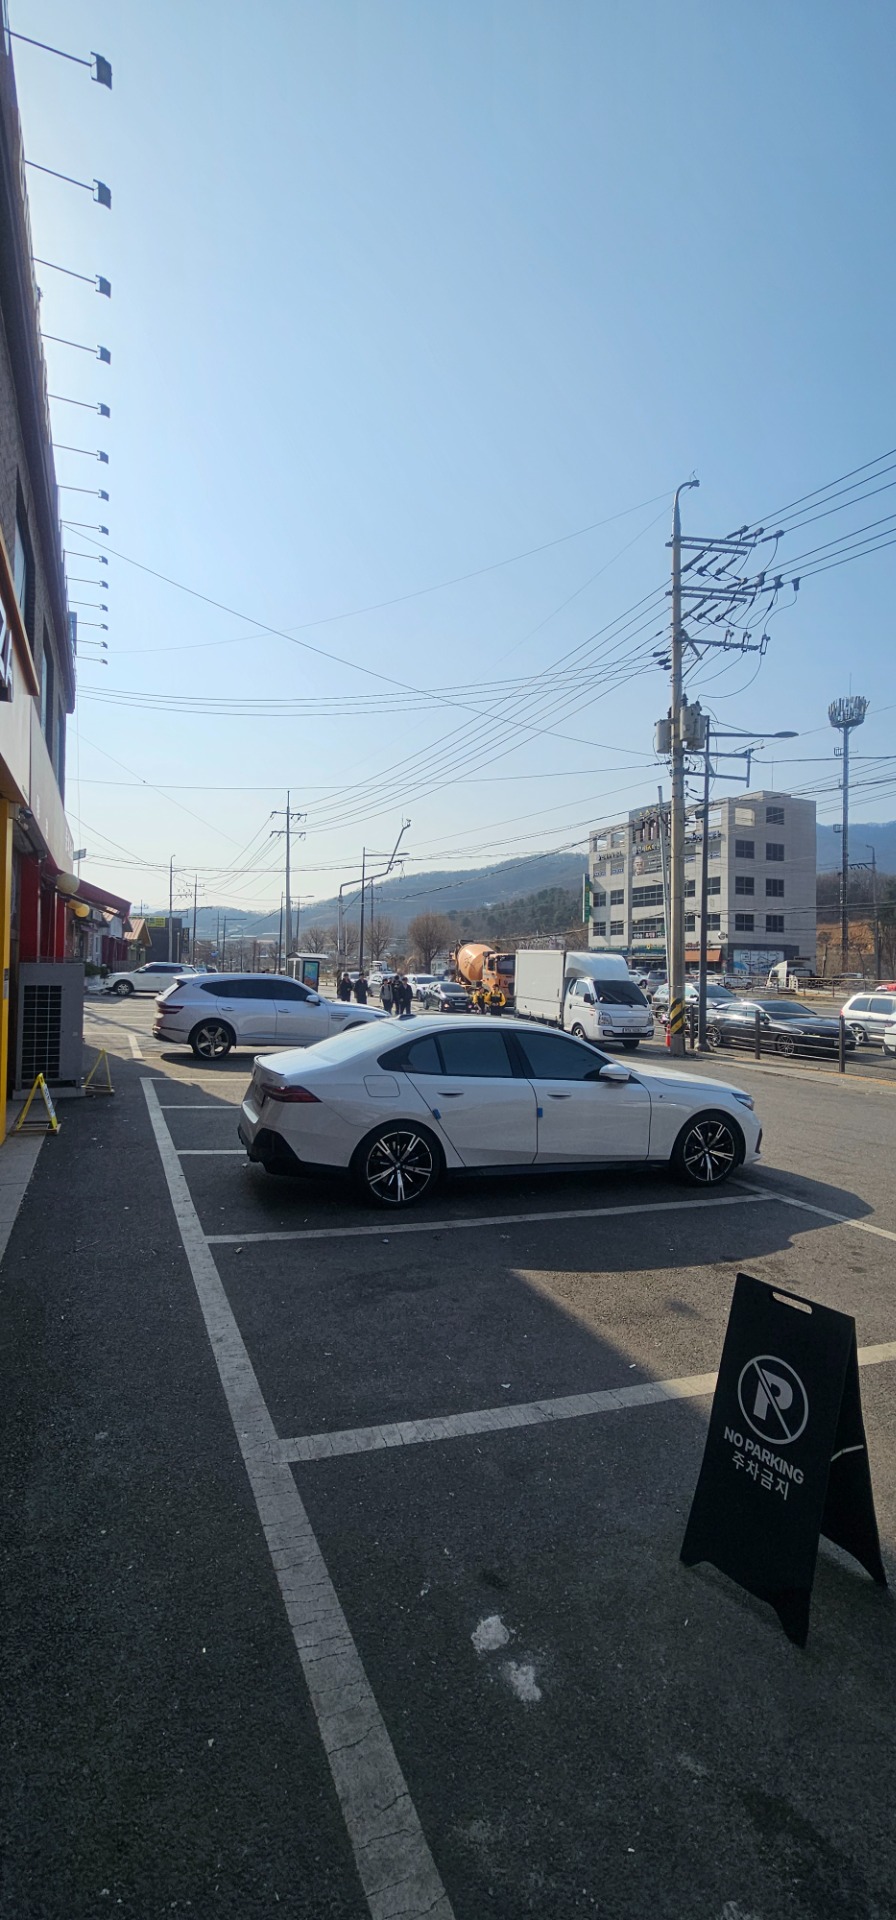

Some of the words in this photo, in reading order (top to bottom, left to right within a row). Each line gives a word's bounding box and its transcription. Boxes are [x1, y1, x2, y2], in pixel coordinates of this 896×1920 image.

[723, 1426, 743, 1447] NO
[745, 1439, 804, 1484] PARKING
[732, 1451, 789, 1500] 주차금지
